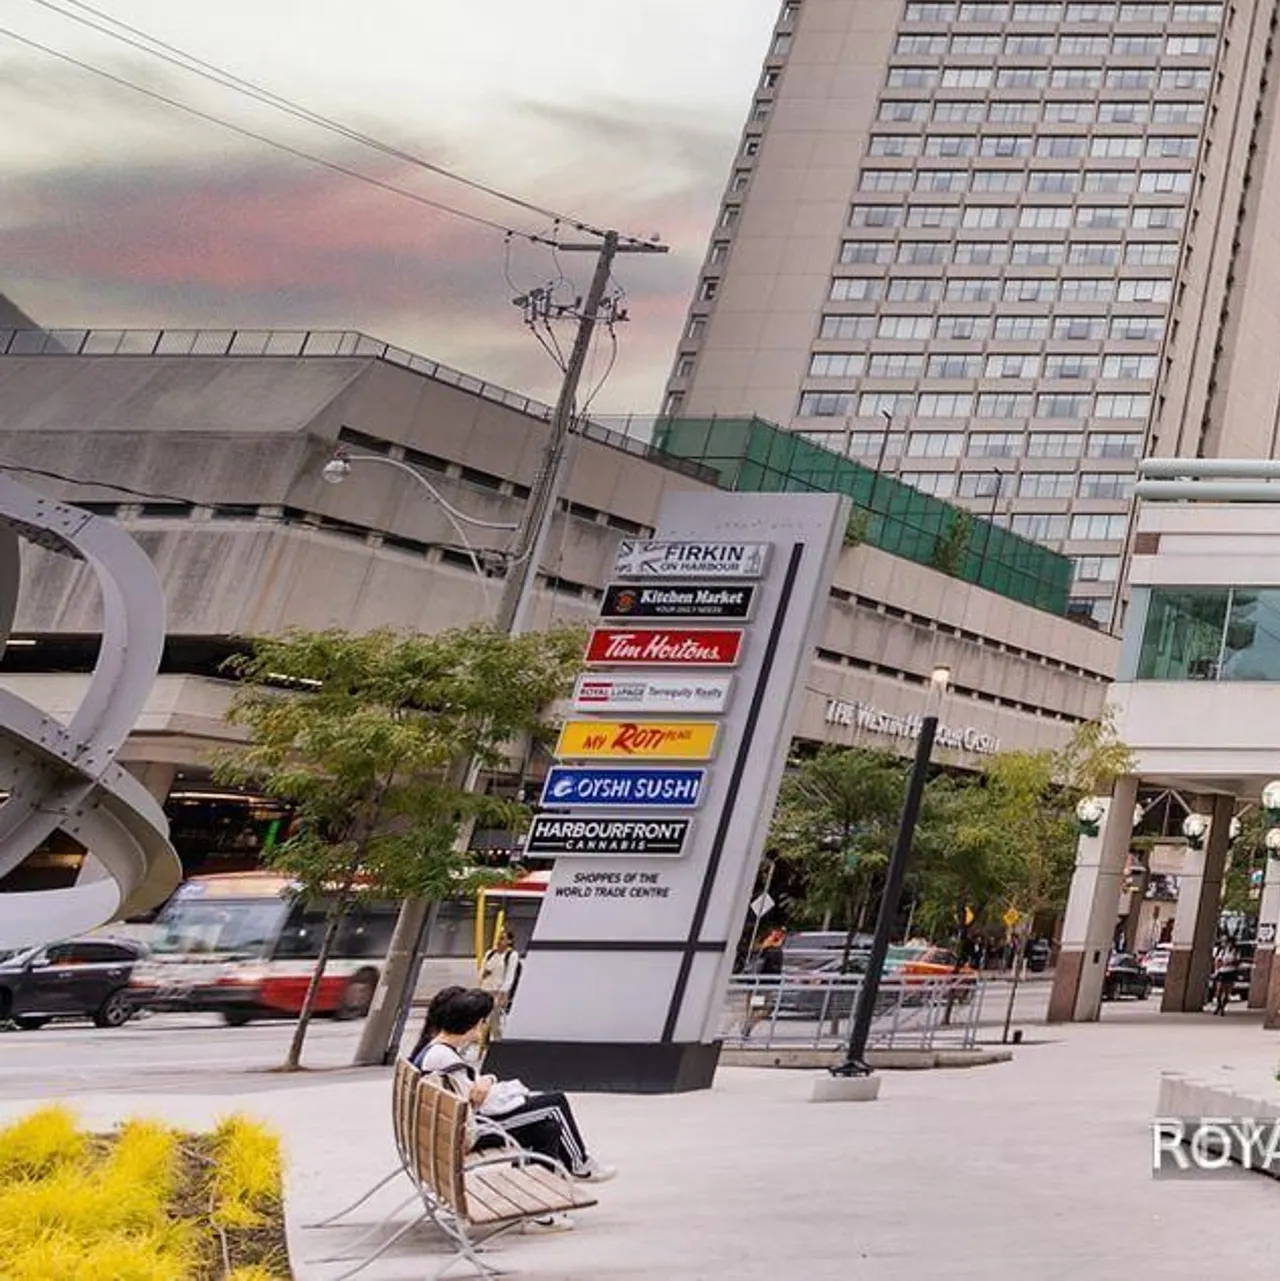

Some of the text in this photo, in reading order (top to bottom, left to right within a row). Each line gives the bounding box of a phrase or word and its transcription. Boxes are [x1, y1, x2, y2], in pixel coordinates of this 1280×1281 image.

[663, 545, 745, 561] FIRKIN
[660, 562, 678, 571] ON
[641, 589, 693, 604] Kitchen
[694, 590, 744, 605] Market
[605, 634, 721, 660] Tim Hortons
[583, 735, 607, 750] MY
[611, 723, 666, 754] ROTI
[577, 779, 699, 799] OYSHI SUSHI
[535, 821, 685, 839] HARBOURFRONT
[564, 840, 648, 851] CANNABIS
[573, 872, 660, 884] SHOPPES OF THE
[555, 886, 671, 899] WORLD TRADE CENTRE
